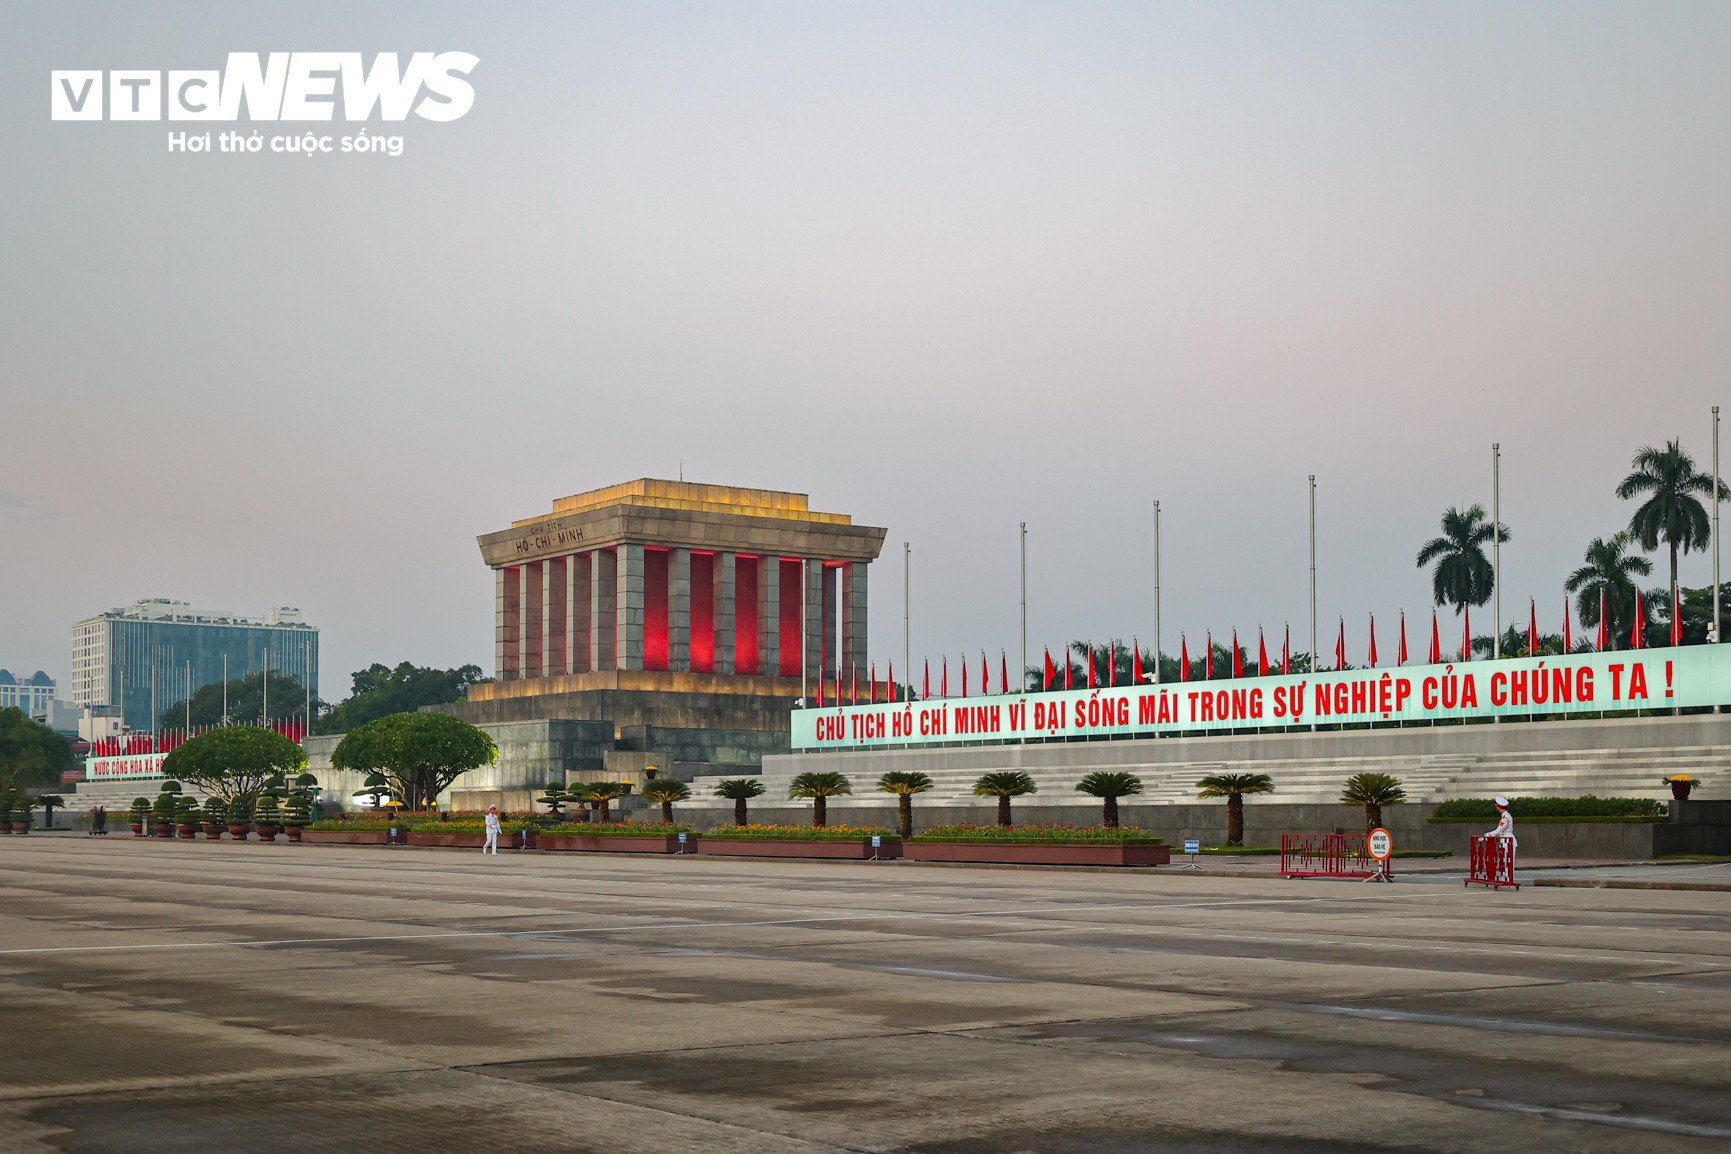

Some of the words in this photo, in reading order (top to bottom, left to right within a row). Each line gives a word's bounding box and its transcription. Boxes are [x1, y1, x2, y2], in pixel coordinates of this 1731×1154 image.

[816, 706, 845, 741] CHỦ
[851, 712, 885, 743] TỊCH
[892, 702, 913, 737] HỒ
[919, 704, 947, 735] CHÍ
[954, 705, 1000, 734] MINH
[1009, 698, 1026, 731] VĨ
[1034, 700, 1066, 735] ĐẠI
[1075, 688, 1129, 728] SỐNG
[1139, 688, 1178, 724] MÃI
[1187, 688, 1264, 722] TRONG
[1273, 680, 1307, 723] SỰ
[1315, 672, 1411, 719] NGHIỆP
[1422, 664, 1478, 711] CỦA
[1490, 661, 1595, 706] CHÚNG
[1608, 662, 1649, 700] TA
